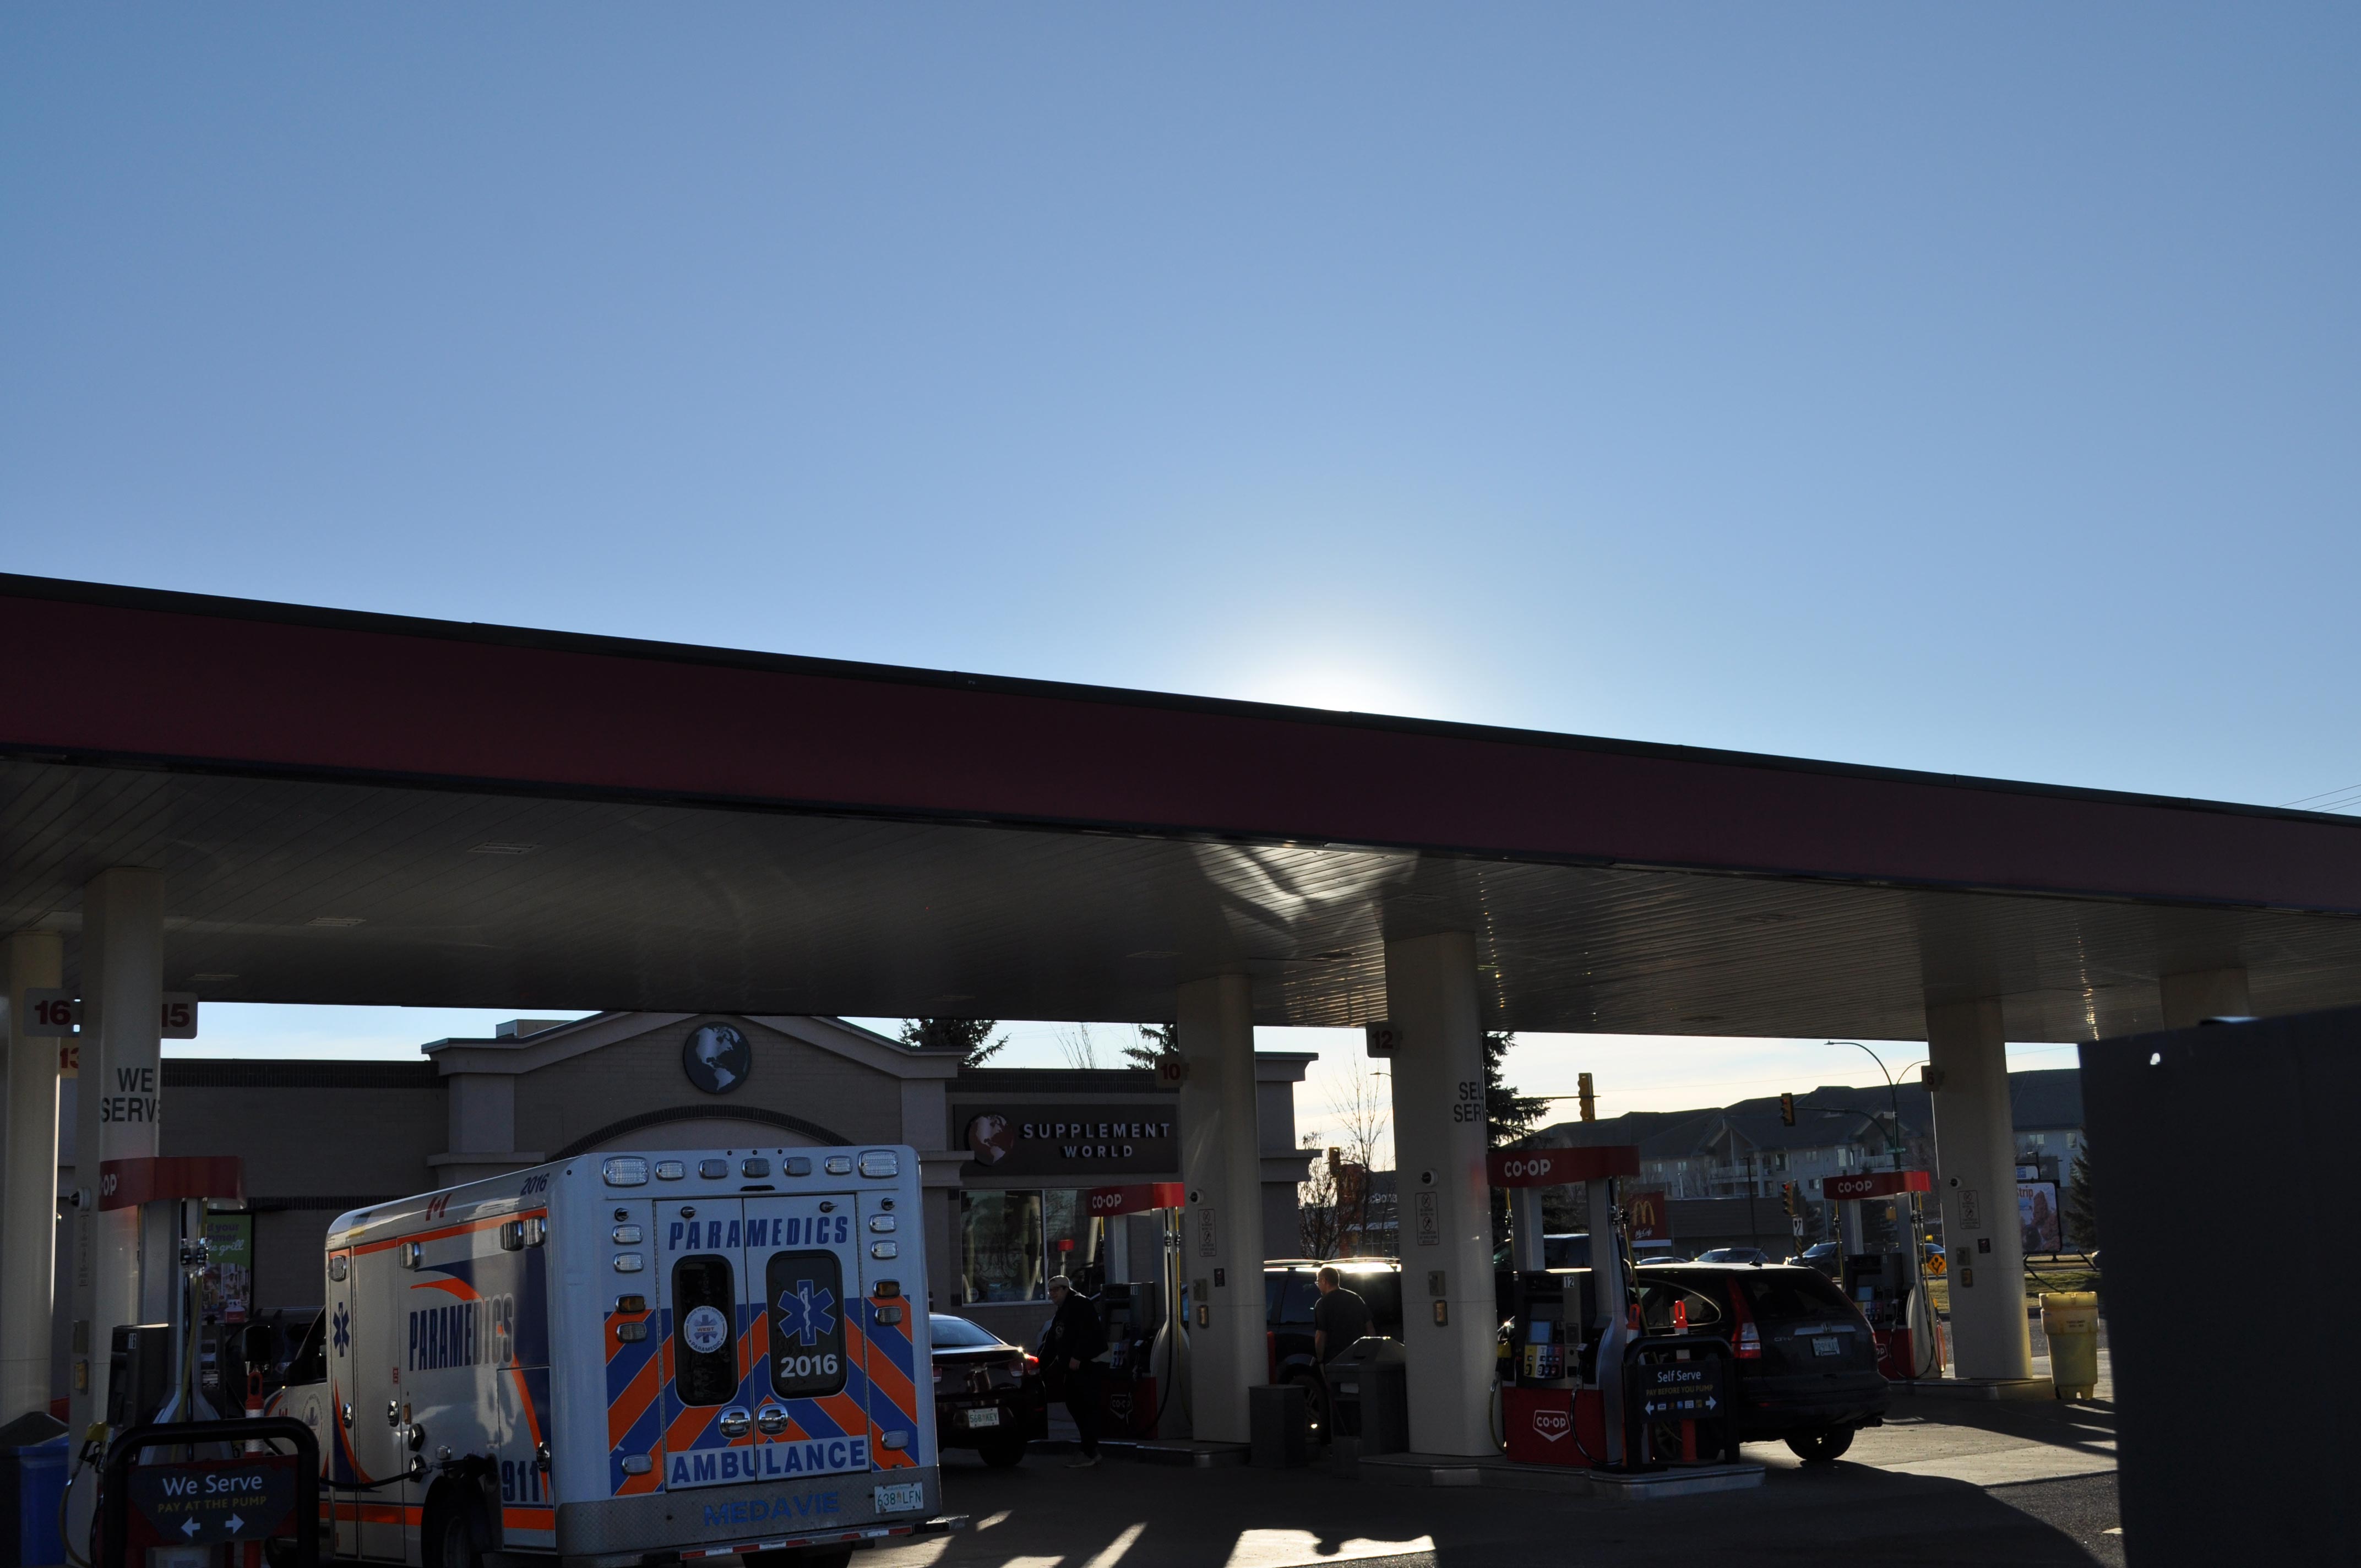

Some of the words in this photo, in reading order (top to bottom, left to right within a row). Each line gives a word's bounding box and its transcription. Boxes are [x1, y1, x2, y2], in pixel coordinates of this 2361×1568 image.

[35, 1000, 70, 1025] 16
[1373, 1031, 1393, 1049] 12
[117, 1068, 153, 1092] WE
[1160, 1063, 1180, 1080] 10
[1927, 1072, 1934, 1085] 6
[101, 1098, 160, 1123] SERV
[1022, 1124, 1169, 1138] SUPPLEMENT
[1064, 1145, 1133, 1158] WORLD
[520, 1173, 550, 1195] 2016
[668, 1216, 848, 1250] PARAMEDICS
[219, 1239, 244, 1256] grill
[1565, 1277, 1574, 1287] 12
[409, 1293, 514, 1371] PARAMEDICS
[690, 1340, 723, 1352] PARAMEDIC
[780, 1354, 838, 1378] 2016
[1657, 1370, 1675, 1382] Self
[1677, 1370, 1701, 1381] Serve
[1646, 1388, 1657, 1396] PAY
[1658, 1386, 1680, 1395] BEFORE
[970, 1414, 982, 1423] 568
[986, 1413, 998, 1421] KEY
[671, 1440, 866, 1484] AMBULANCE
[162, 1477, 197, 1496] We
[205, 1474, 263, 1493] Serve
[502, 1460, 539, 1502] 911
[158, 1502, 181, 1513] PAY
[185, 1501, 200, 1511] AT
[205, 1499, 228, 1509] THE
[232, 1495, 267, 1507] PUMP
[878, 1493, 895, 1506] 638
[903, 1490, 921, 1504] LFN
[704, 1492, 840, 1527] MEDAVIE
